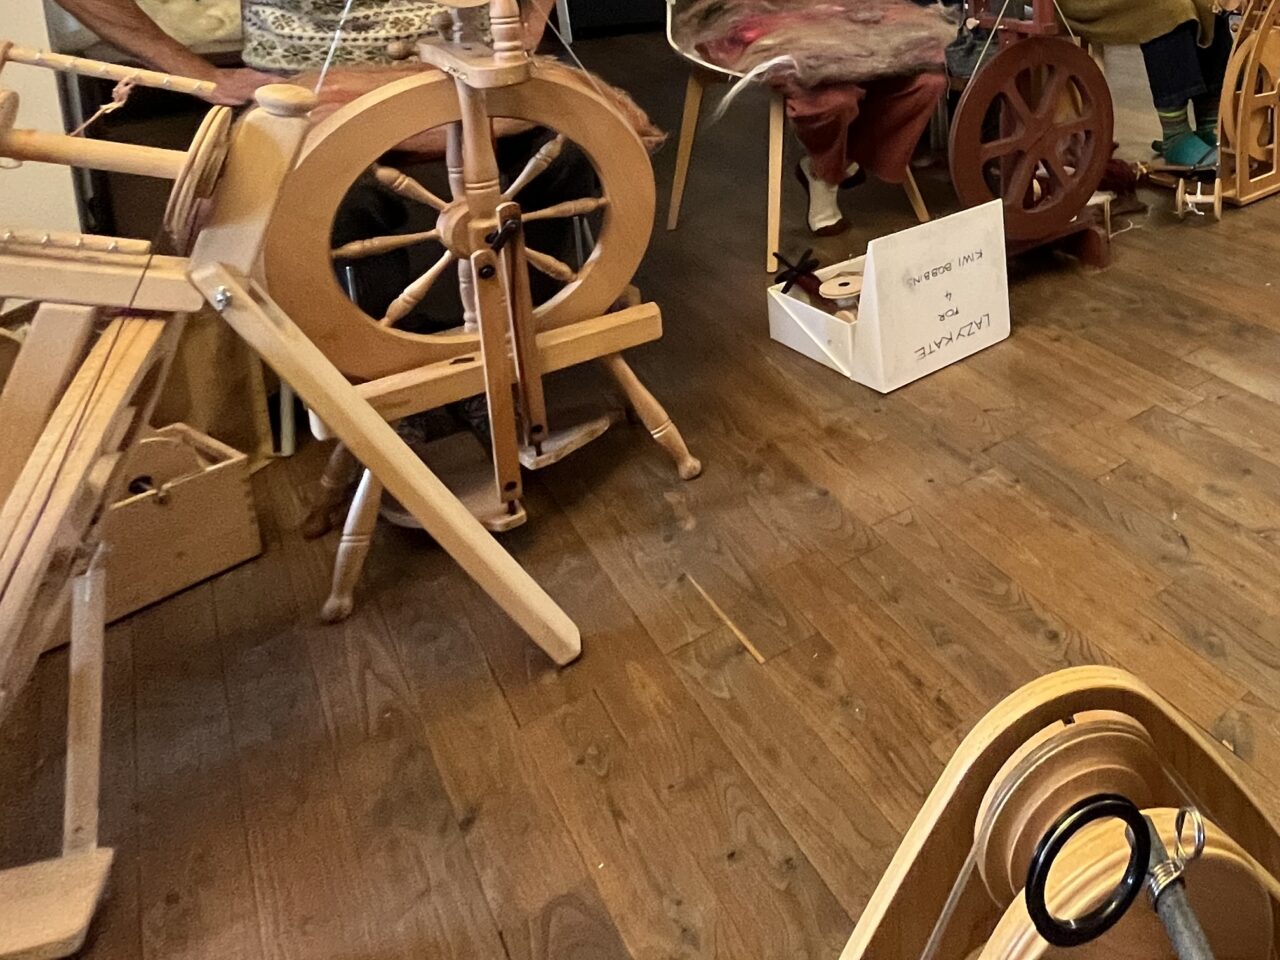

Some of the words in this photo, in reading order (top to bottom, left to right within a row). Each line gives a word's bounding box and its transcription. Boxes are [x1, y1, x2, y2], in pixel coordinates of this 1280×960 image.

[958, 248, 983, 267] KIWI
[945, 291, 953, 302] 4
[937, 307, 959, 322] FOR
